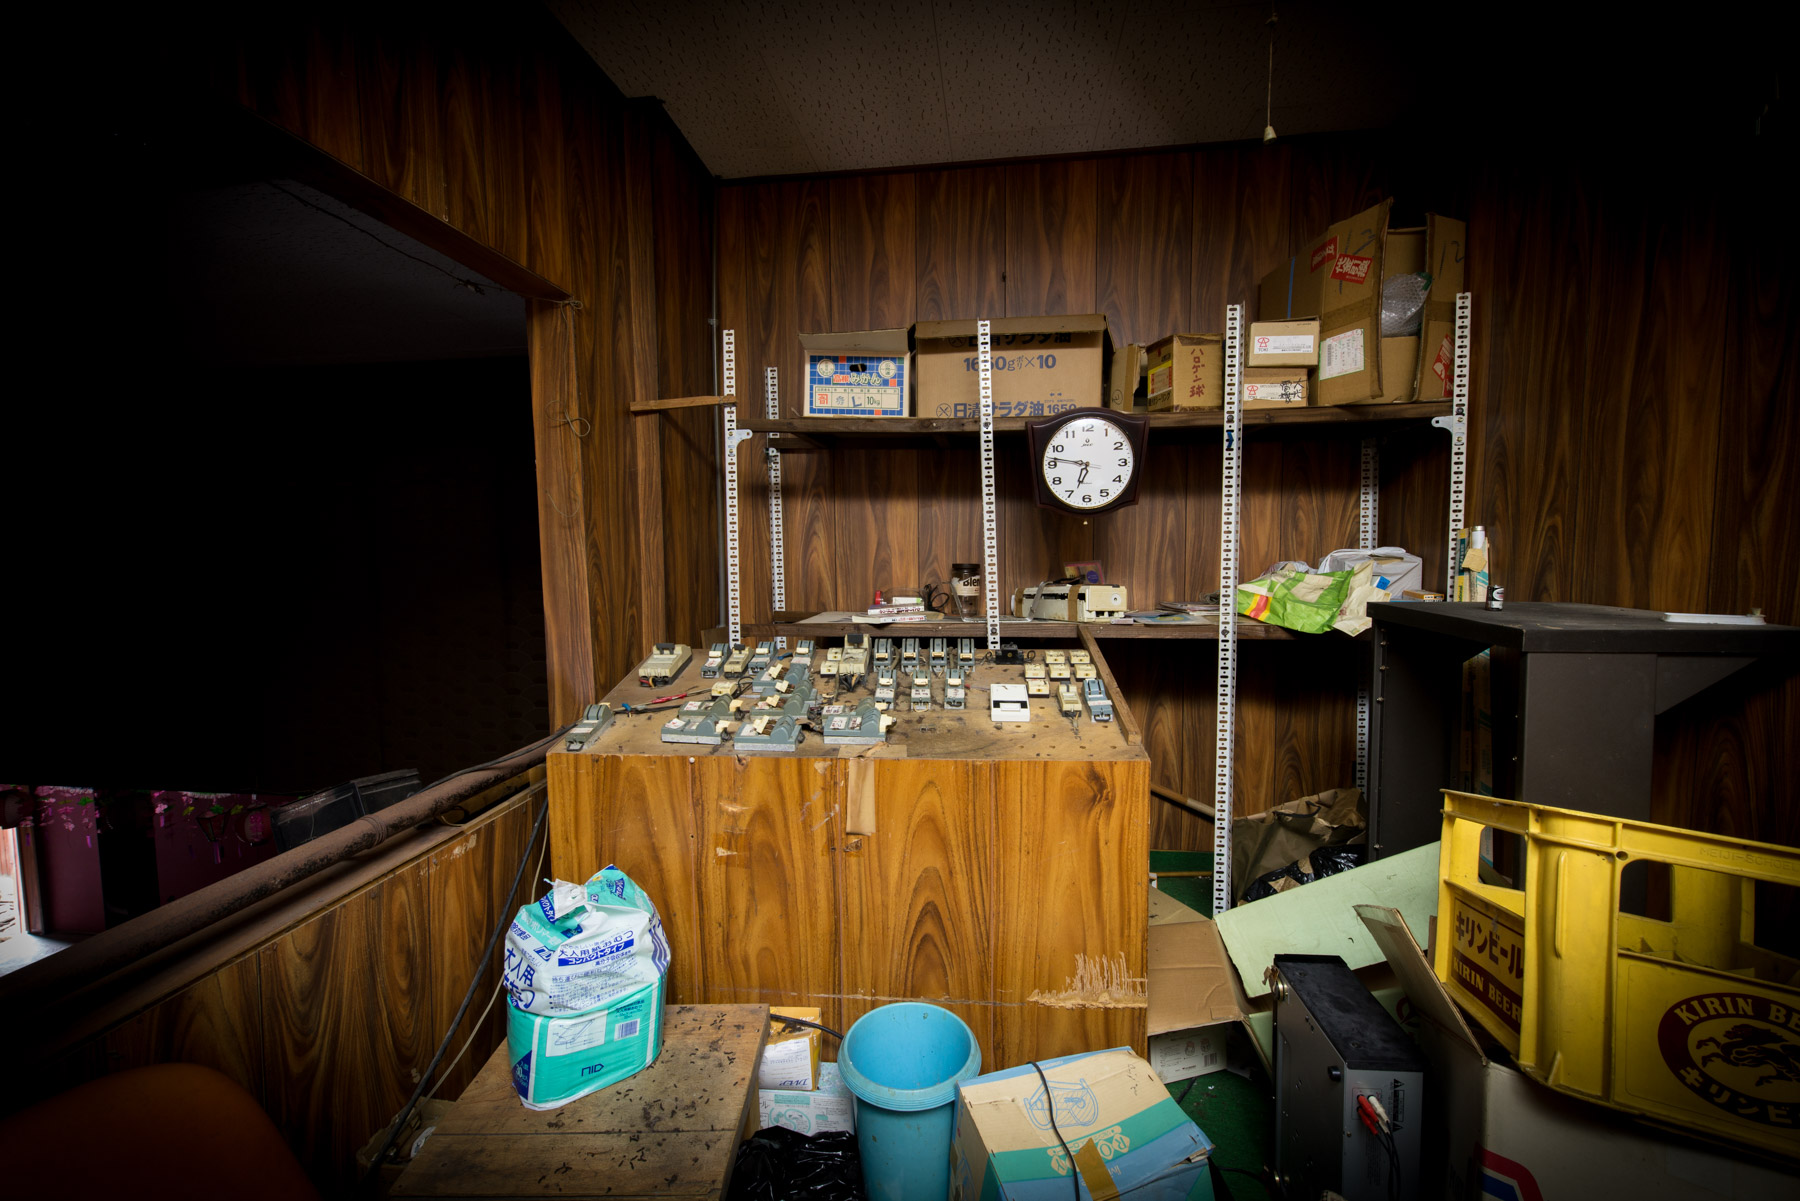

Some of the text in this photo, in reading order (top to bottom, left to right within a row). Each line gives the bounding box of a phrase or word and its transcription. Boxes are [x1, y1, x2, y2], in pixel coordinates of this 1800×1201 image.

[1189, 348, 1206, 398] ハロゲン球
[1052, 445, 1064, 453] 10
[1113, 442, 1123, 450] 2
[1048, 460, 1057, 469] 9
[1052, 477, 1062, 485] 8
[1112, 475, 1122, 483] 4
[1065, 490, 1075, 498] 7
[1100, 489, 1110, 498] 5
[1082, 495, 1092, 503] 6
[1455, 911, 1524, 980] キリンビール
[568, 942, 626, 965] コンパクトタイプ
[504, 947, 536, 988] 大人用
[1453, 956, 1522, 1024] KIRIN BEER
[1673, 996, 1754, 1026] KIRIN
[1679, 1066, 1800, 1125] キリンビ
